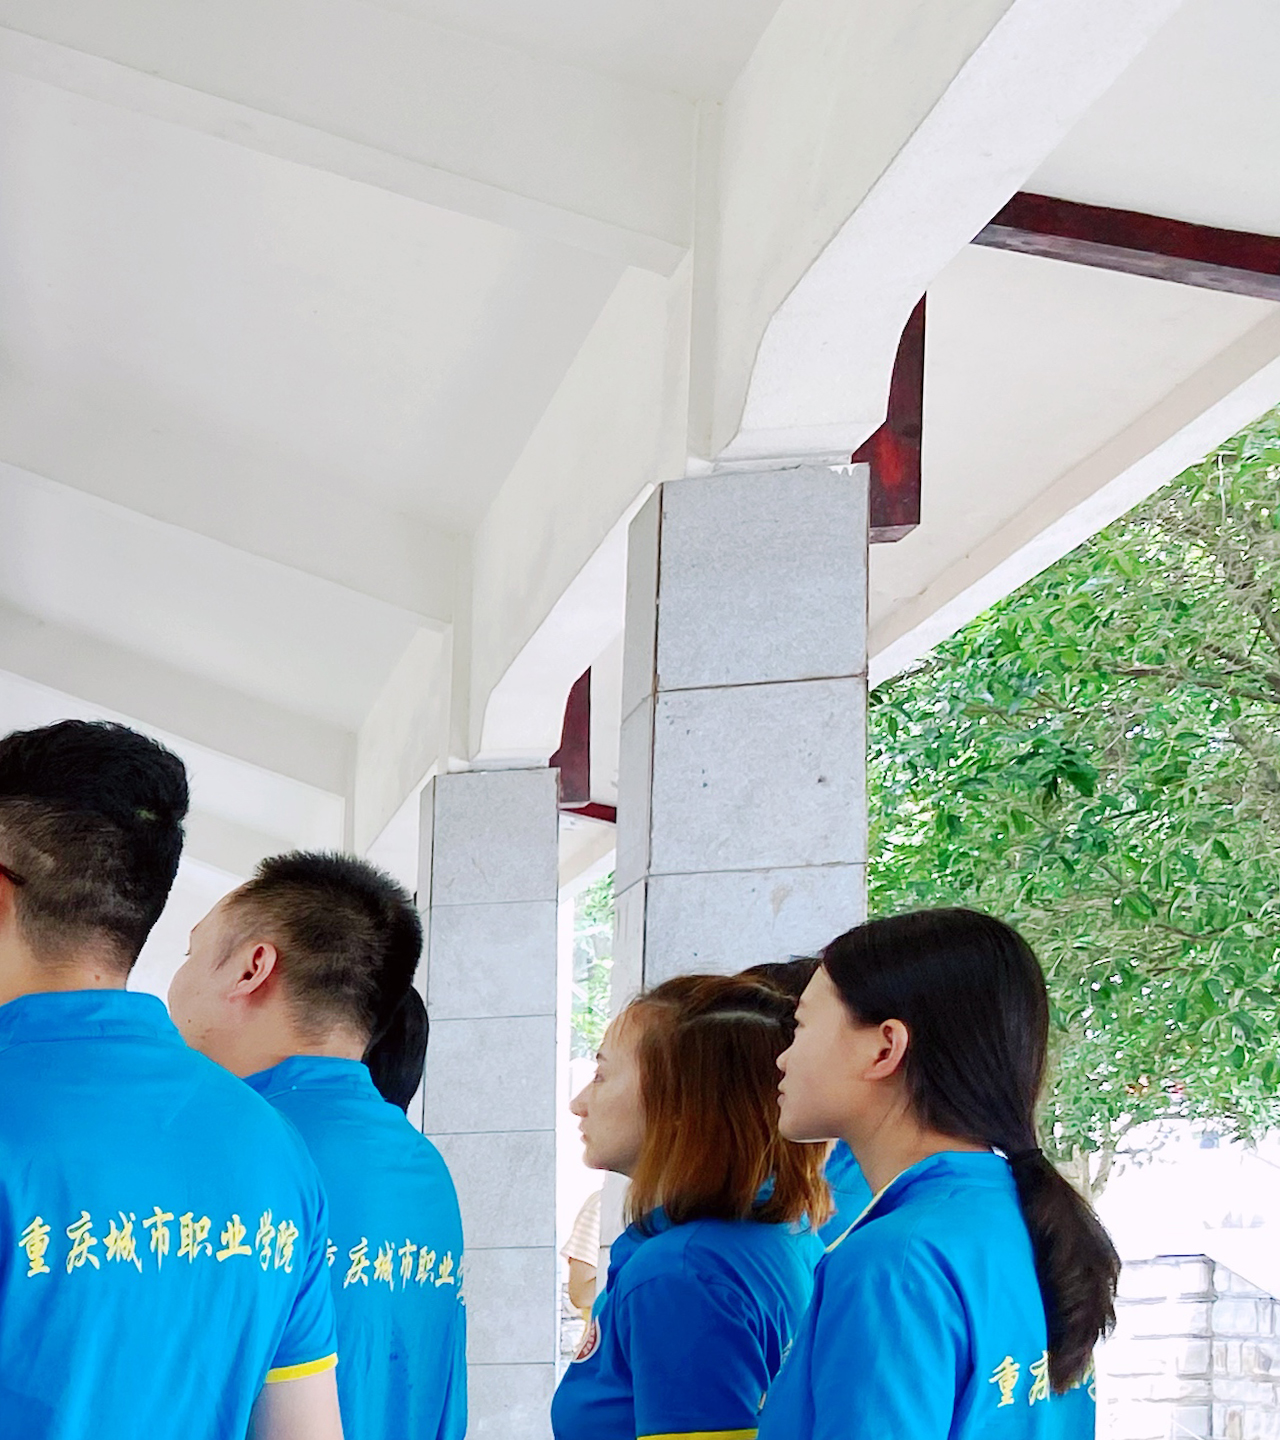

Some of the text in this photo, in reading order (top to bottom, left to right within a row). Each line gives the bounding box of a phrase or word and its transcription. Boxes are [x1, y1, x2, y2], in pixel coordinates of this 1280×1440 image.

[18, 1207, 300, 1278] 重庆城市职业学院
